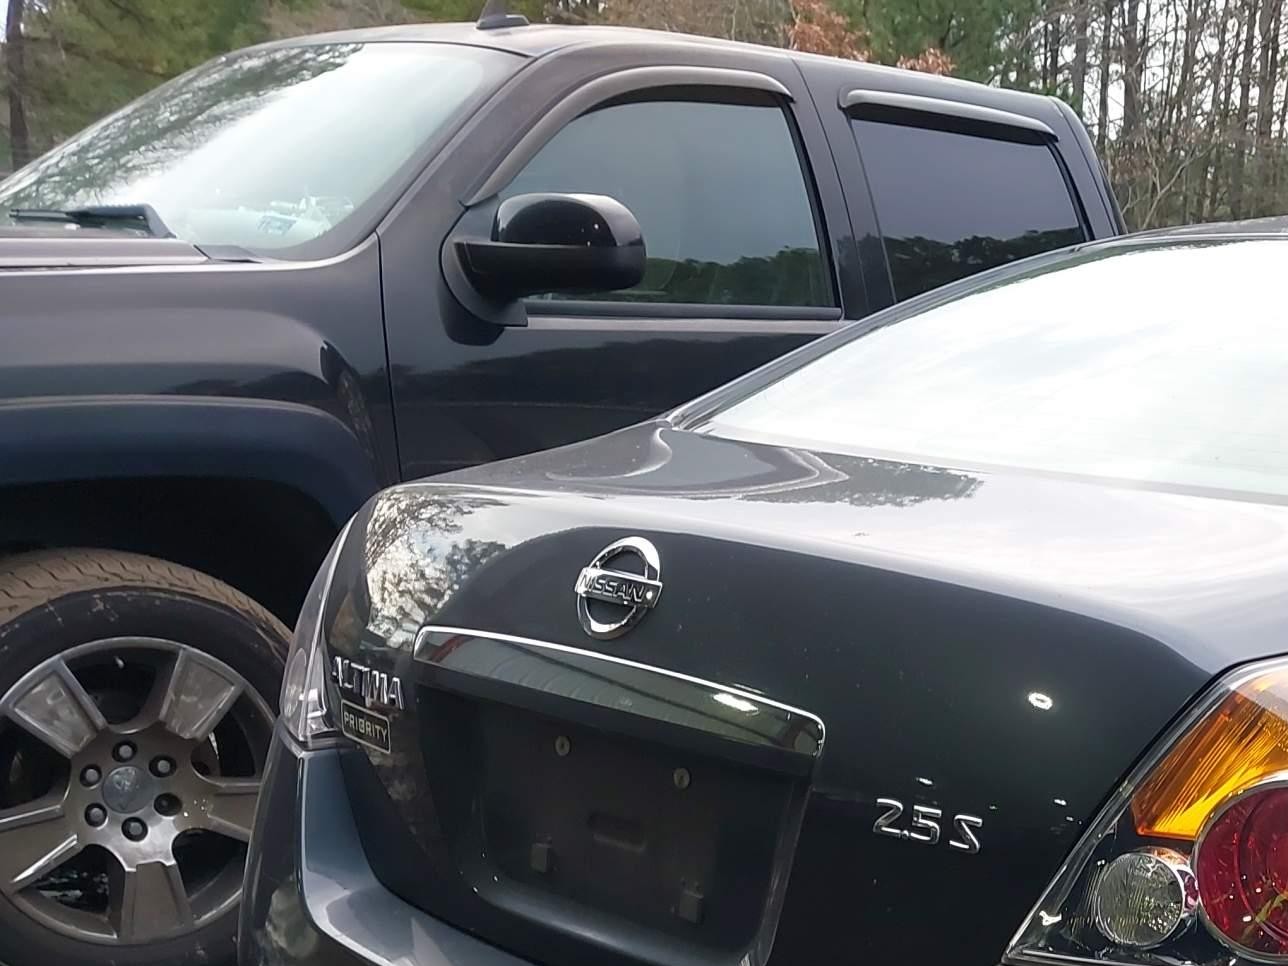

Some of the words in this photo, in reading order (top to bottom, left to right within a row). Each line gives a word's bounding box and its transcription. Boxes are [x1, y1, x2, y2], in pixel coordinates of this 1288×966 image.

[577, 571, 646, 602] NISSAN
[331, 656, 405, 710] ALTIMA
[343, 711, 388, 742] PRIORITY
[873, 798, 942, 845] 2.5
[949, 814, 983, 854] S
